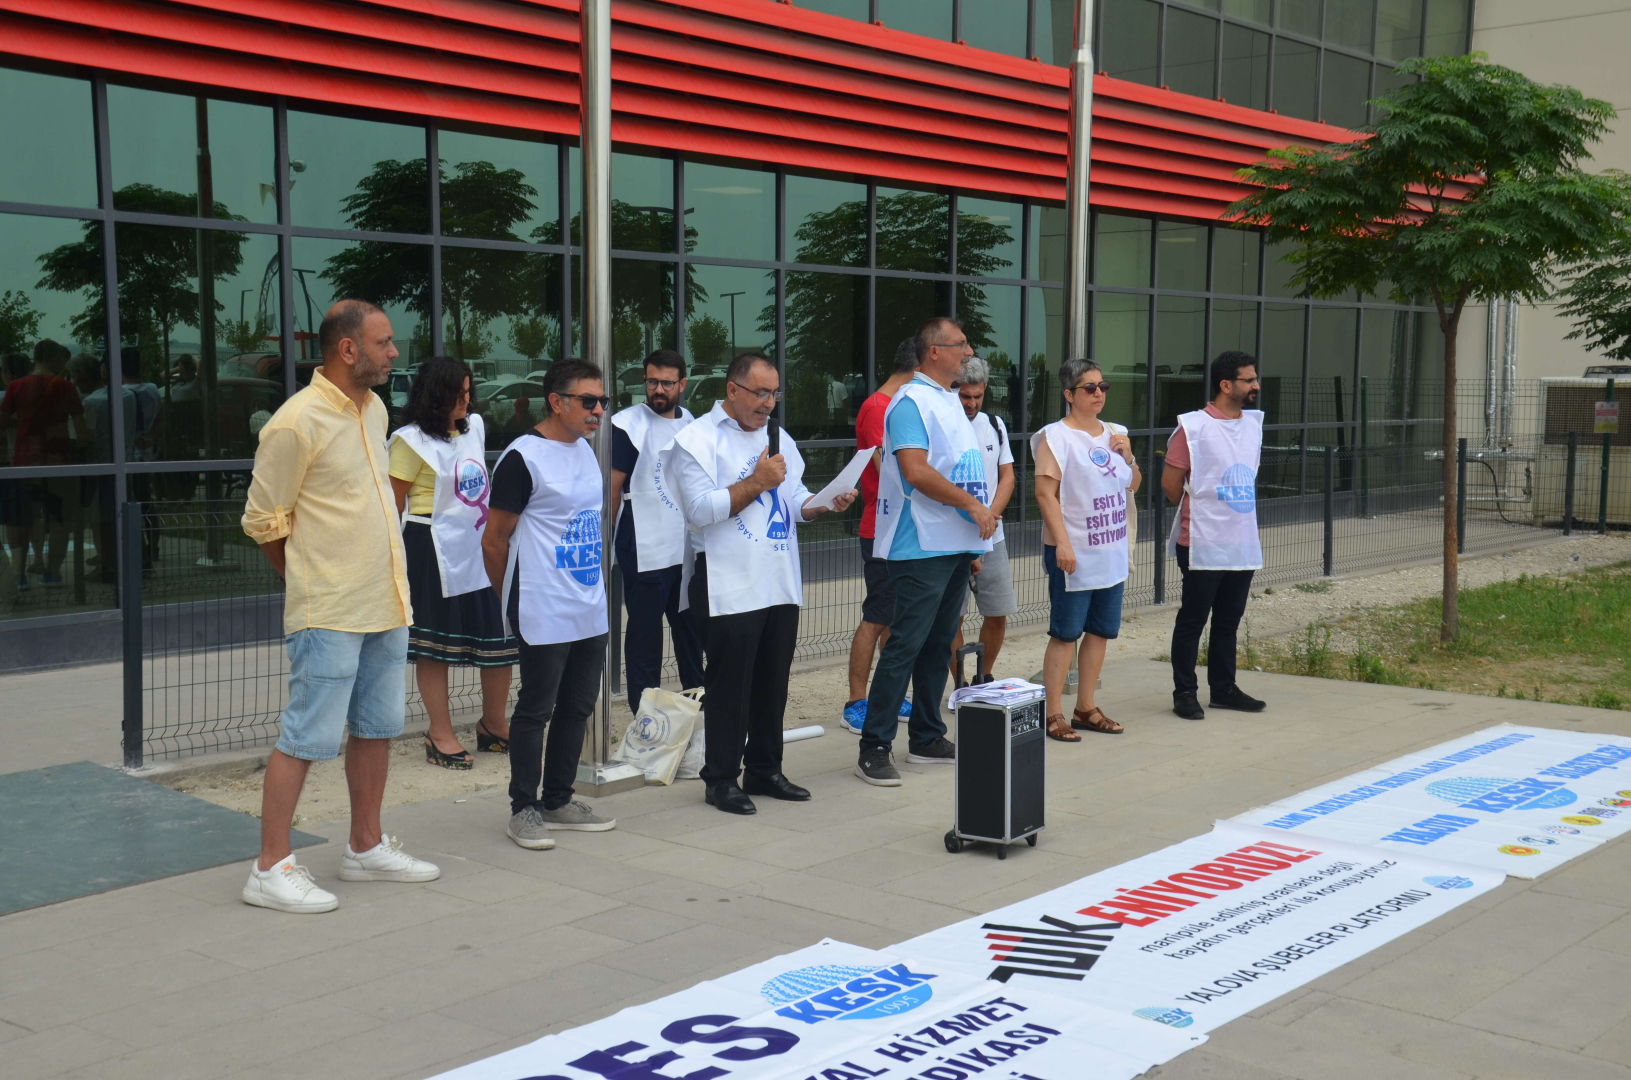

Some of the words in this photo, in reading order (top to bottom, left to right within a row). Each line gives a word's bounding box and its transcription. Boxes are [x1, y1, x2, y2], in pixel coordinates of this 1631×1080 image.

[459, 475, 486, 492] KESK
[654, 476, 661, 485] VE
[1215, 485, 1256, 501] KES
[1085, 512, 1110, 531] EŞİT
[1092, 494, 1116, 512] EŞİT
[1262, 812, 1318, 830] KAMU
[1379, 813, 1481, 846] YALOVA
[1457, 777, 1568, 814] KESK
[1138, 922, 1215, 953] manipüle
[1210, 899, 1271, 923] edilmiş
[1261, 874, 1325, 901] oranlarla
[1163, 932, 1233, 960] hayatın
[1226, 902, 1302, 935] gerçekleri
[1289, 894, 1319, 905] ile
[1307, 859, 1398, 897] konuşuyoruz
[1174, 968, 1269, 1005] YALOVA
[1251, 930, 1346, 973] ŞUBELER
[1329, 888, 1433, 938] PLATFORMU
[773, 962, 940, 1025] KESK
[874, 995, 920, 1014] 1995
[873, 995, 1029, 1064] HİZMET
[1152, 1007, 1193, 1025] ESK
[515, 1013, 801, 1080] ES
[905, 1022, 1063, 1080] DİKASI
